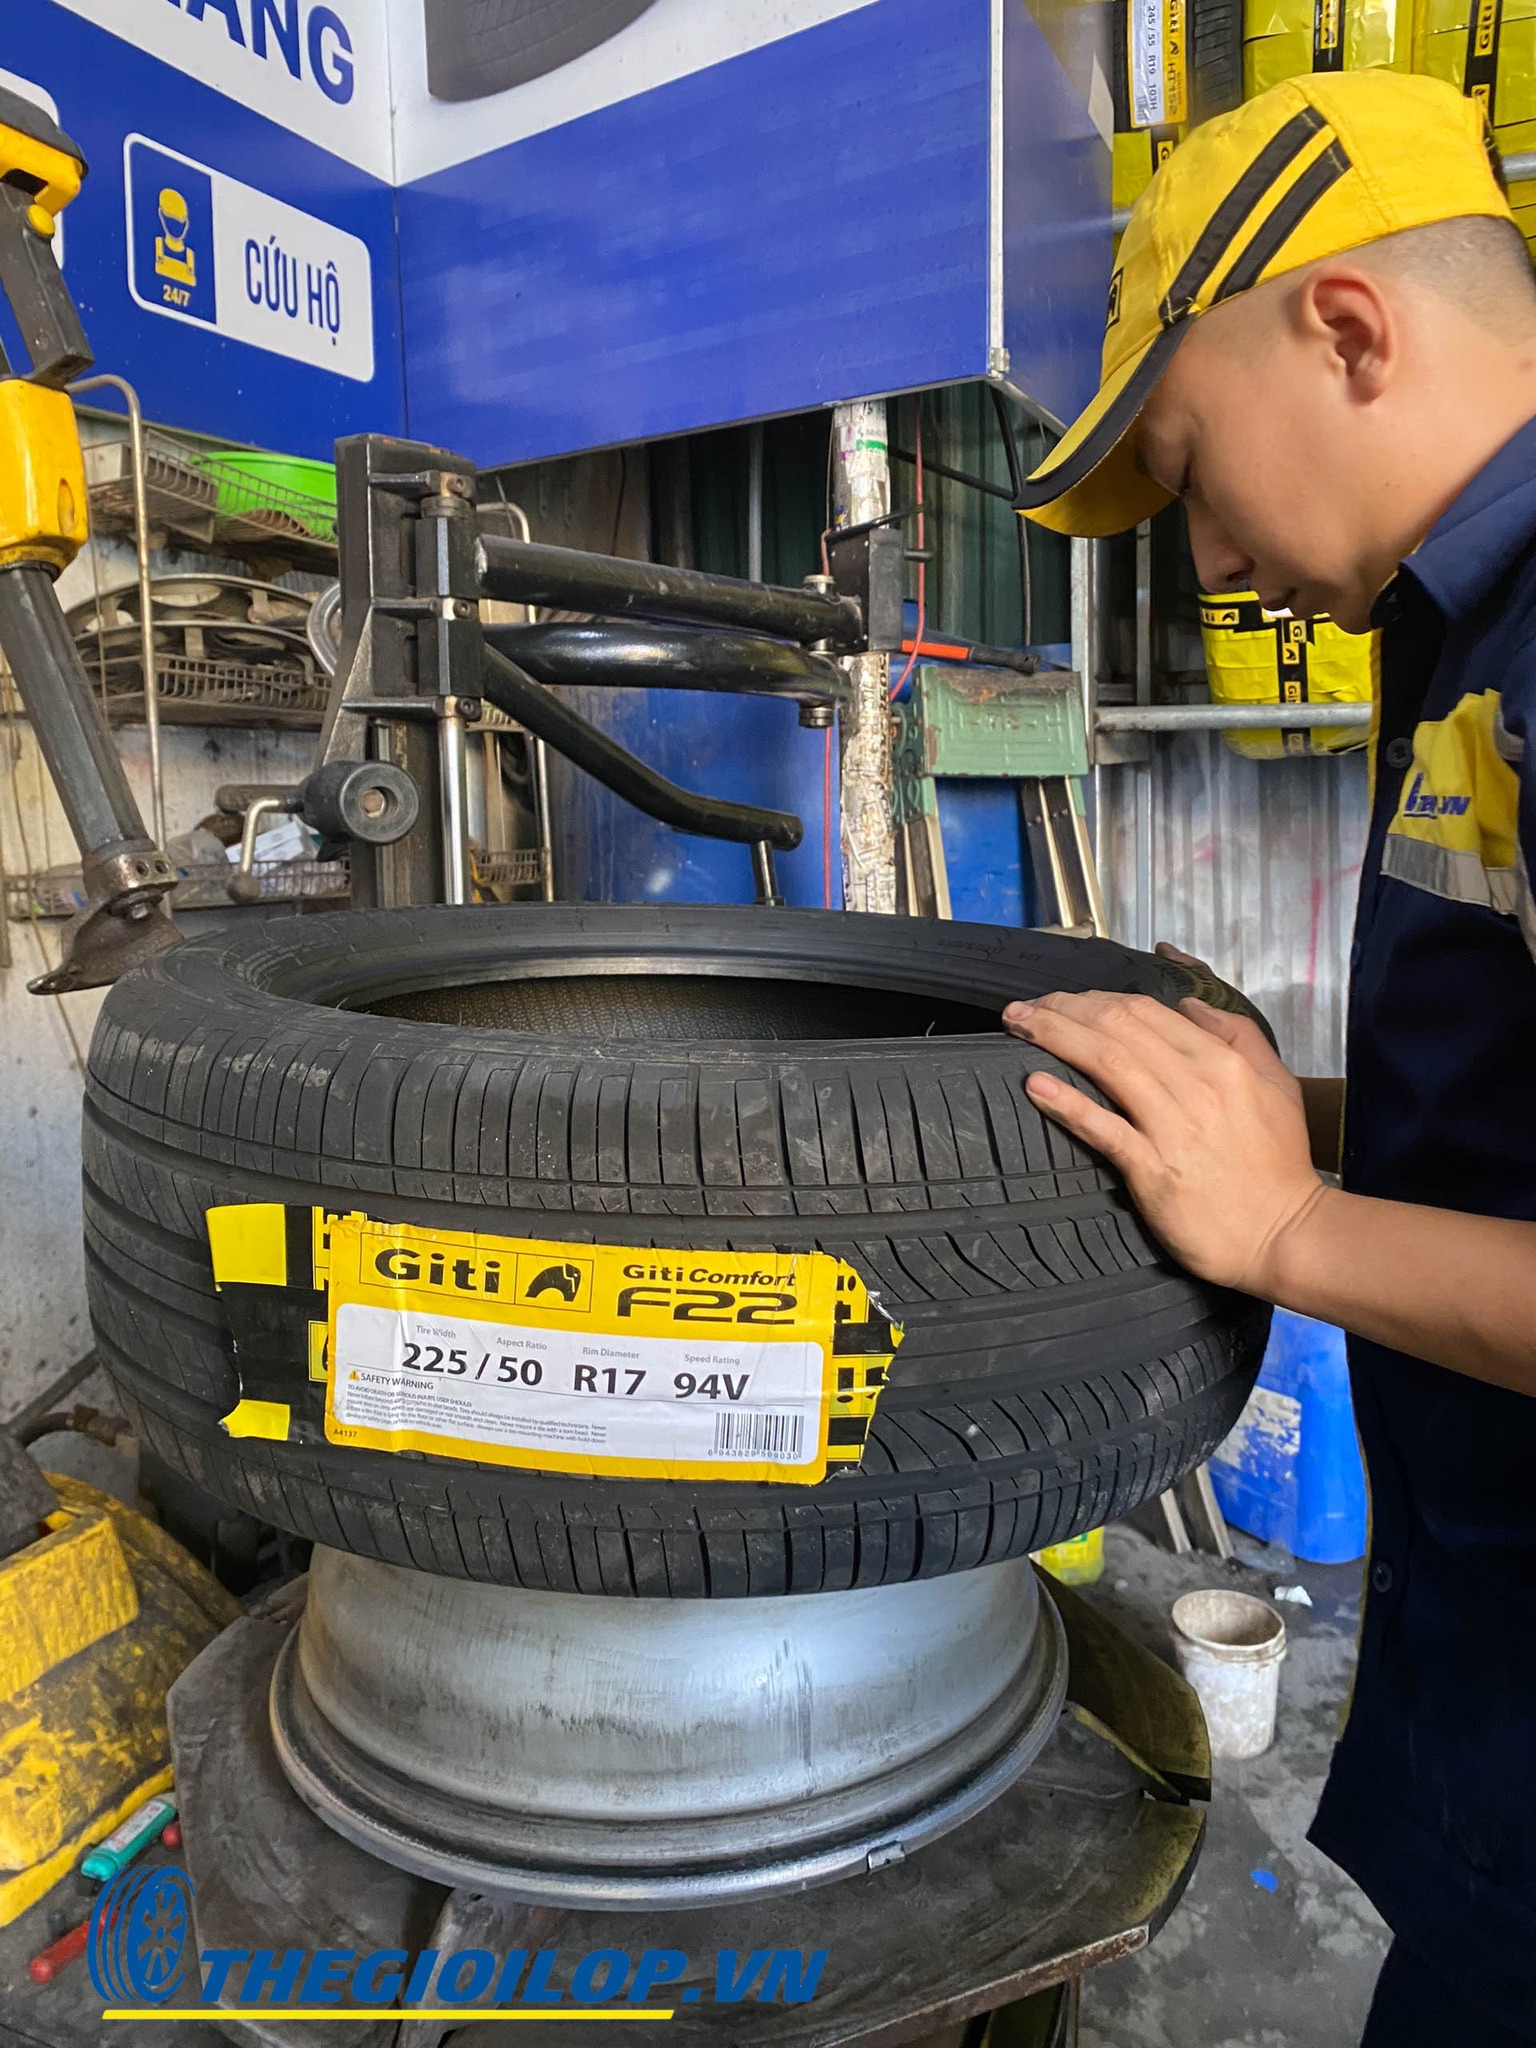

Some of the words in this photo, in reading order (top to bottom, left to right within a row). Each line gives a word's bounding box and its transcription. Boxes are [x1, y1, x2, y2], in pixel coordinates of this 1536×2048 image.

[1147, 6, 1156, 24] 245
[1147, 33, 1156, 47] 55
[1148, 55, 1156, 75] R19
[1149, 84, 1158, 110] 103H
[163, 284, 191, 307] 24/7
[245, 235, 298, 318] CỨU
[307, 260, 340, 346] HỘ
[374, 1248, 501, 1294] Giti
[617, 1287, 798, 1325] F22
[416, 1325, 431, 1335] Tire
[432, 1328, 456, 1339] Width
[496, 1337, 524, 1348] Aspect
[526, 1340, 547, 1350] Ratio
[583, 1347, 599, 1355] Rim
[600, 1348, 640, 1359] Diameter
[685, 1354, 710, 1364] Speed
[712, 1355, 740, 1366] Rating
[402, 1342, 467, 1375] 225
[497, 1356, 543, 1386] 50
[574, 1364, 647, 1395] R17
[674, 1372, 750, 1400] 94V
[361, 1373, 390, 1384] SAFETY
[391, 1377, 434, 1390] WARNING
[333, 1429, 358, 1437] A4137
